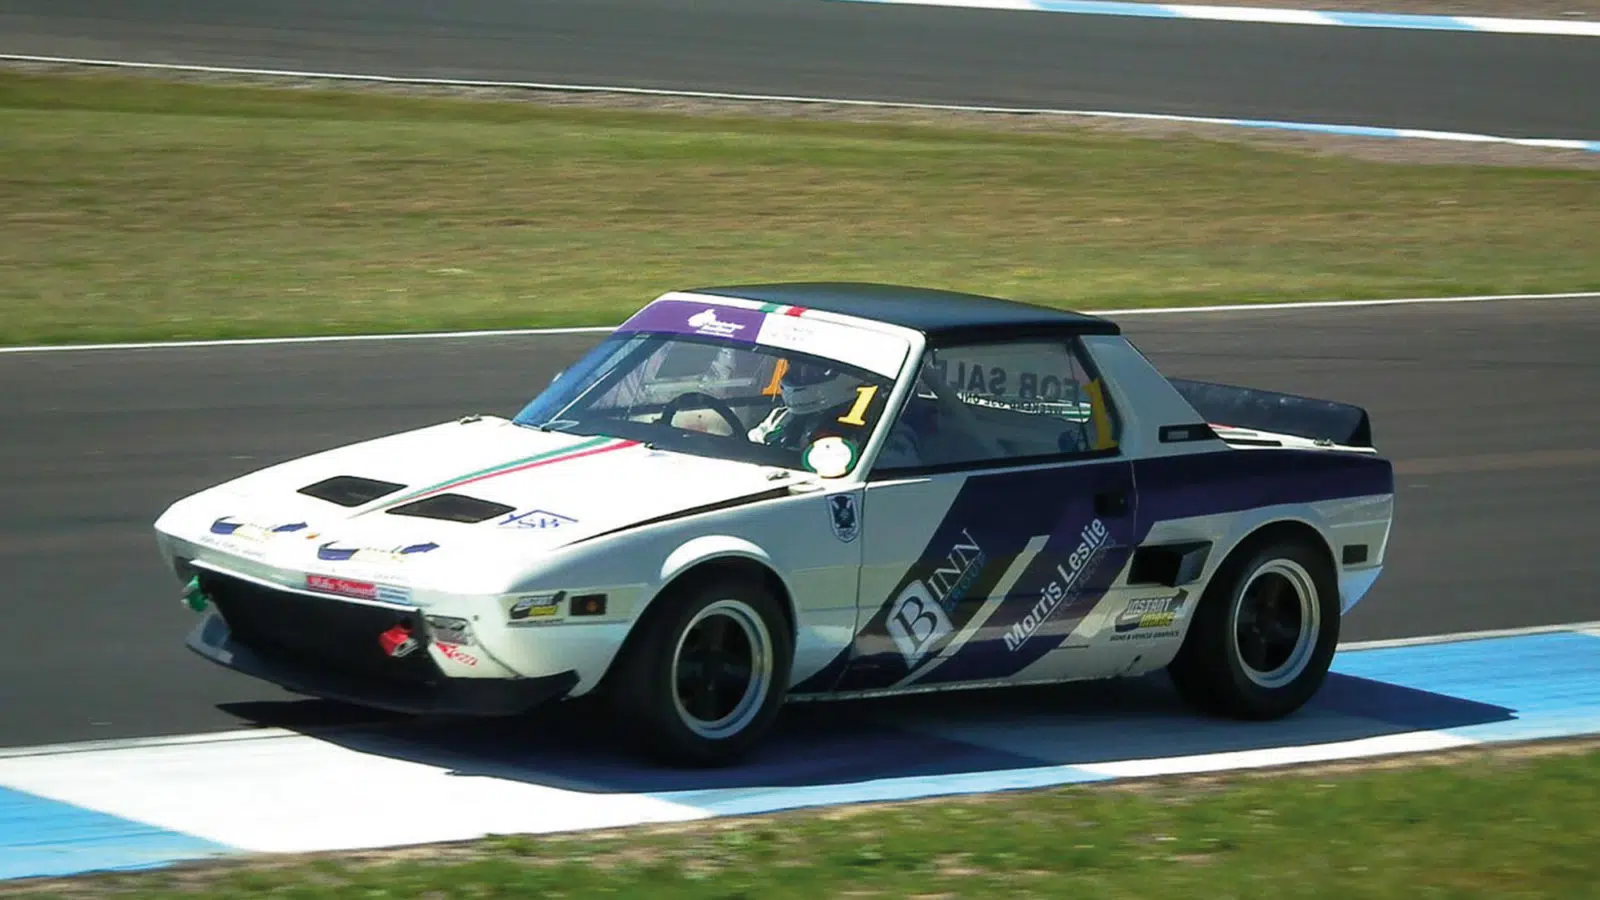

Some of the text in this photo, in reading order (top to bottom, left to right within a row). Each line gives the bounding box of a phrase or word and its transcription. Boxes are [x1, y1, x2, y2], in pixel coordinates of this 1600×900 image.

[837, 384, 878, 426] 1
[1082, 378, 1120, 449] 1
[1003, 581, 1063, 651] Morris
[1056, 518, 1106, 583] Leslie
[1127, 597, 1173, 613] INSTANT
